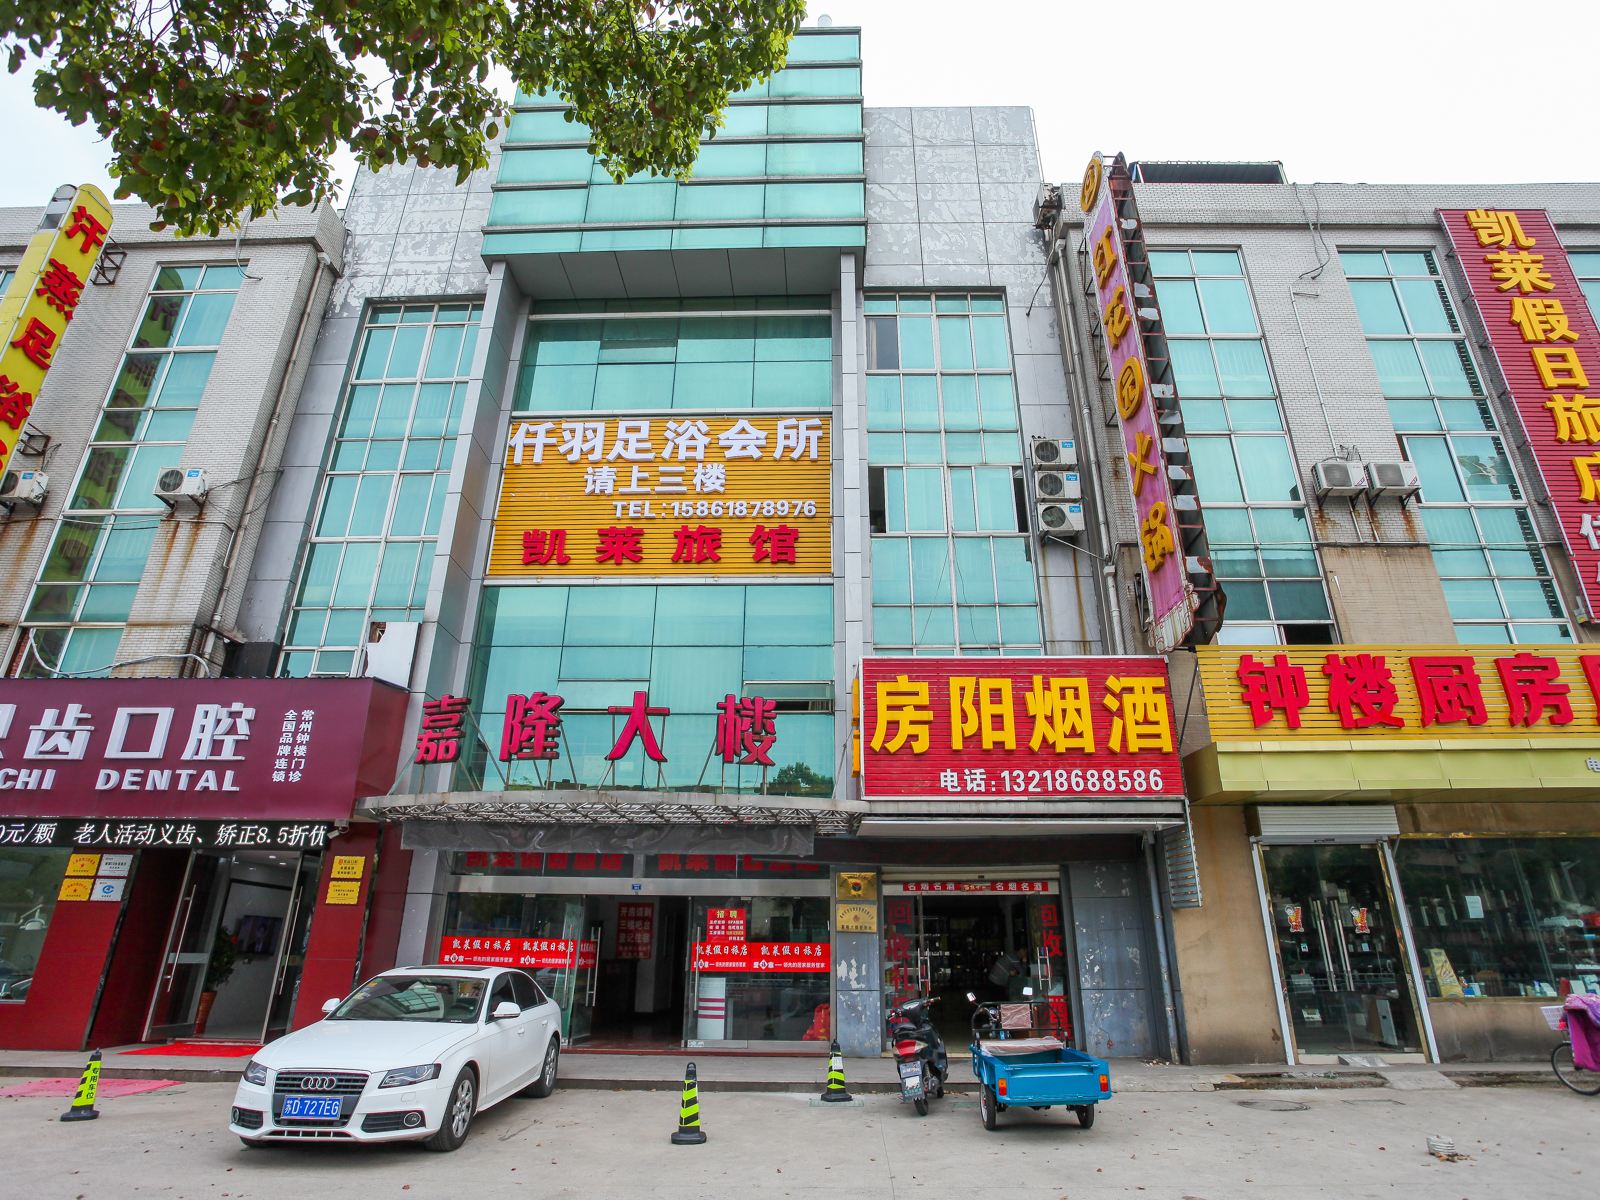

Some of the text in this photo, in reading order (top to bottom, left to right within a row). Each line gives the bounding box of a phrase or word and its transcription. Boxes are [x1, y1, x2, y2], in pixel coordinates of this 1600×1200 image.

[0, 205, 108, 472] 汗蒸足浴
[509, 418, 823, 465] 仟羽足浴会所
[584, 463, 726, 495] 请上三楼
[522, 524, 799, 565] 凯莱旅馆
[0, 702, 256, 761] 齿口腔
[414, 691, 777, 766] 嘉隆大楼
[870, 675, 1173, 754] 房阳烟酒
[272, 710, 298, 782] 全国品牌连锁
[288, 710, 315, 783] 常州钟楼门诊
[95, 769, 240, 792] DENTAL
[0, 822, 57, 845] 元/颗
[996, 882, 1042, 891] 名烟名酒
[452, 938, 511, 952] 凯莱假日旅店
[760, 944, 822, 956] 凯莱假日旅店
